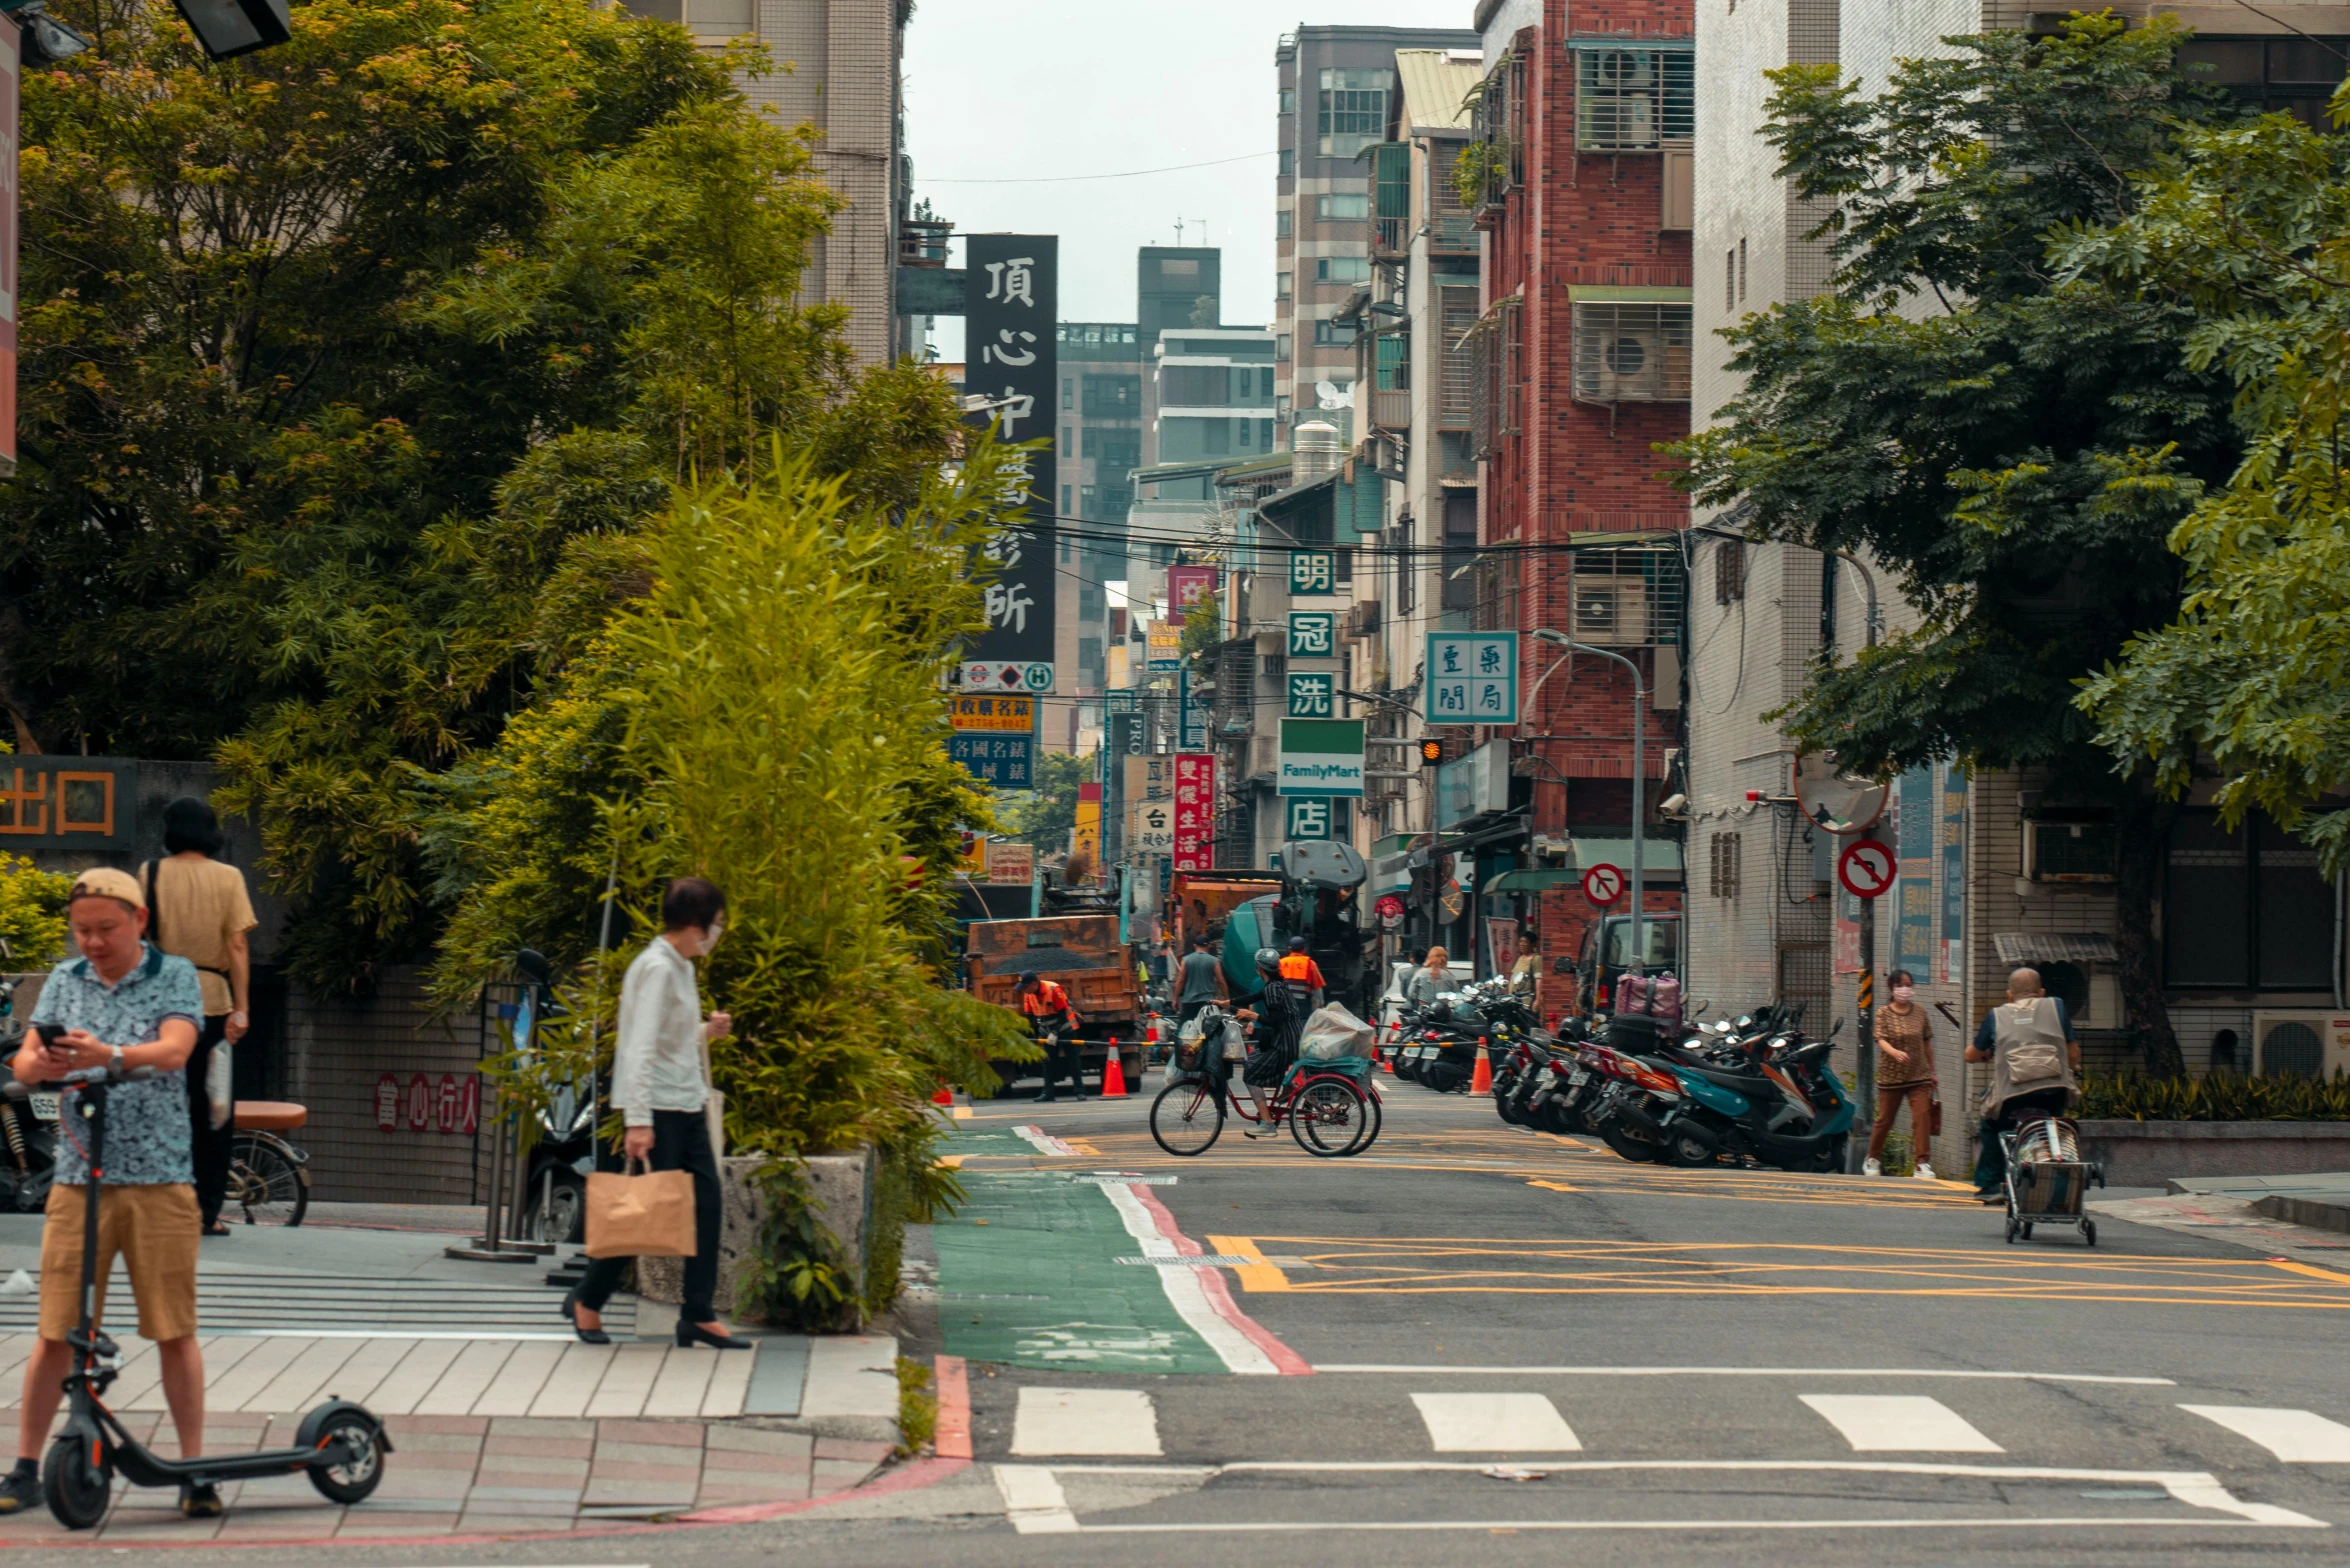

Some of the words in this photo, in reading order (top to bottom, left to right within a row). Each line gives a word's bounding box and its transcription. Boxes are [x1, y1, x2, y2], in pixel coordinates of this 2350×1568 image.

[1291, 554, 1330, 836] 明冠洗店
[1479, 645, 1501, 711] 藥局
[0, 767, 115, 836] 出口
[1283, 764, 1360, 780] FamilyMart
[377, 1079, 477, 1128] 當心行人
